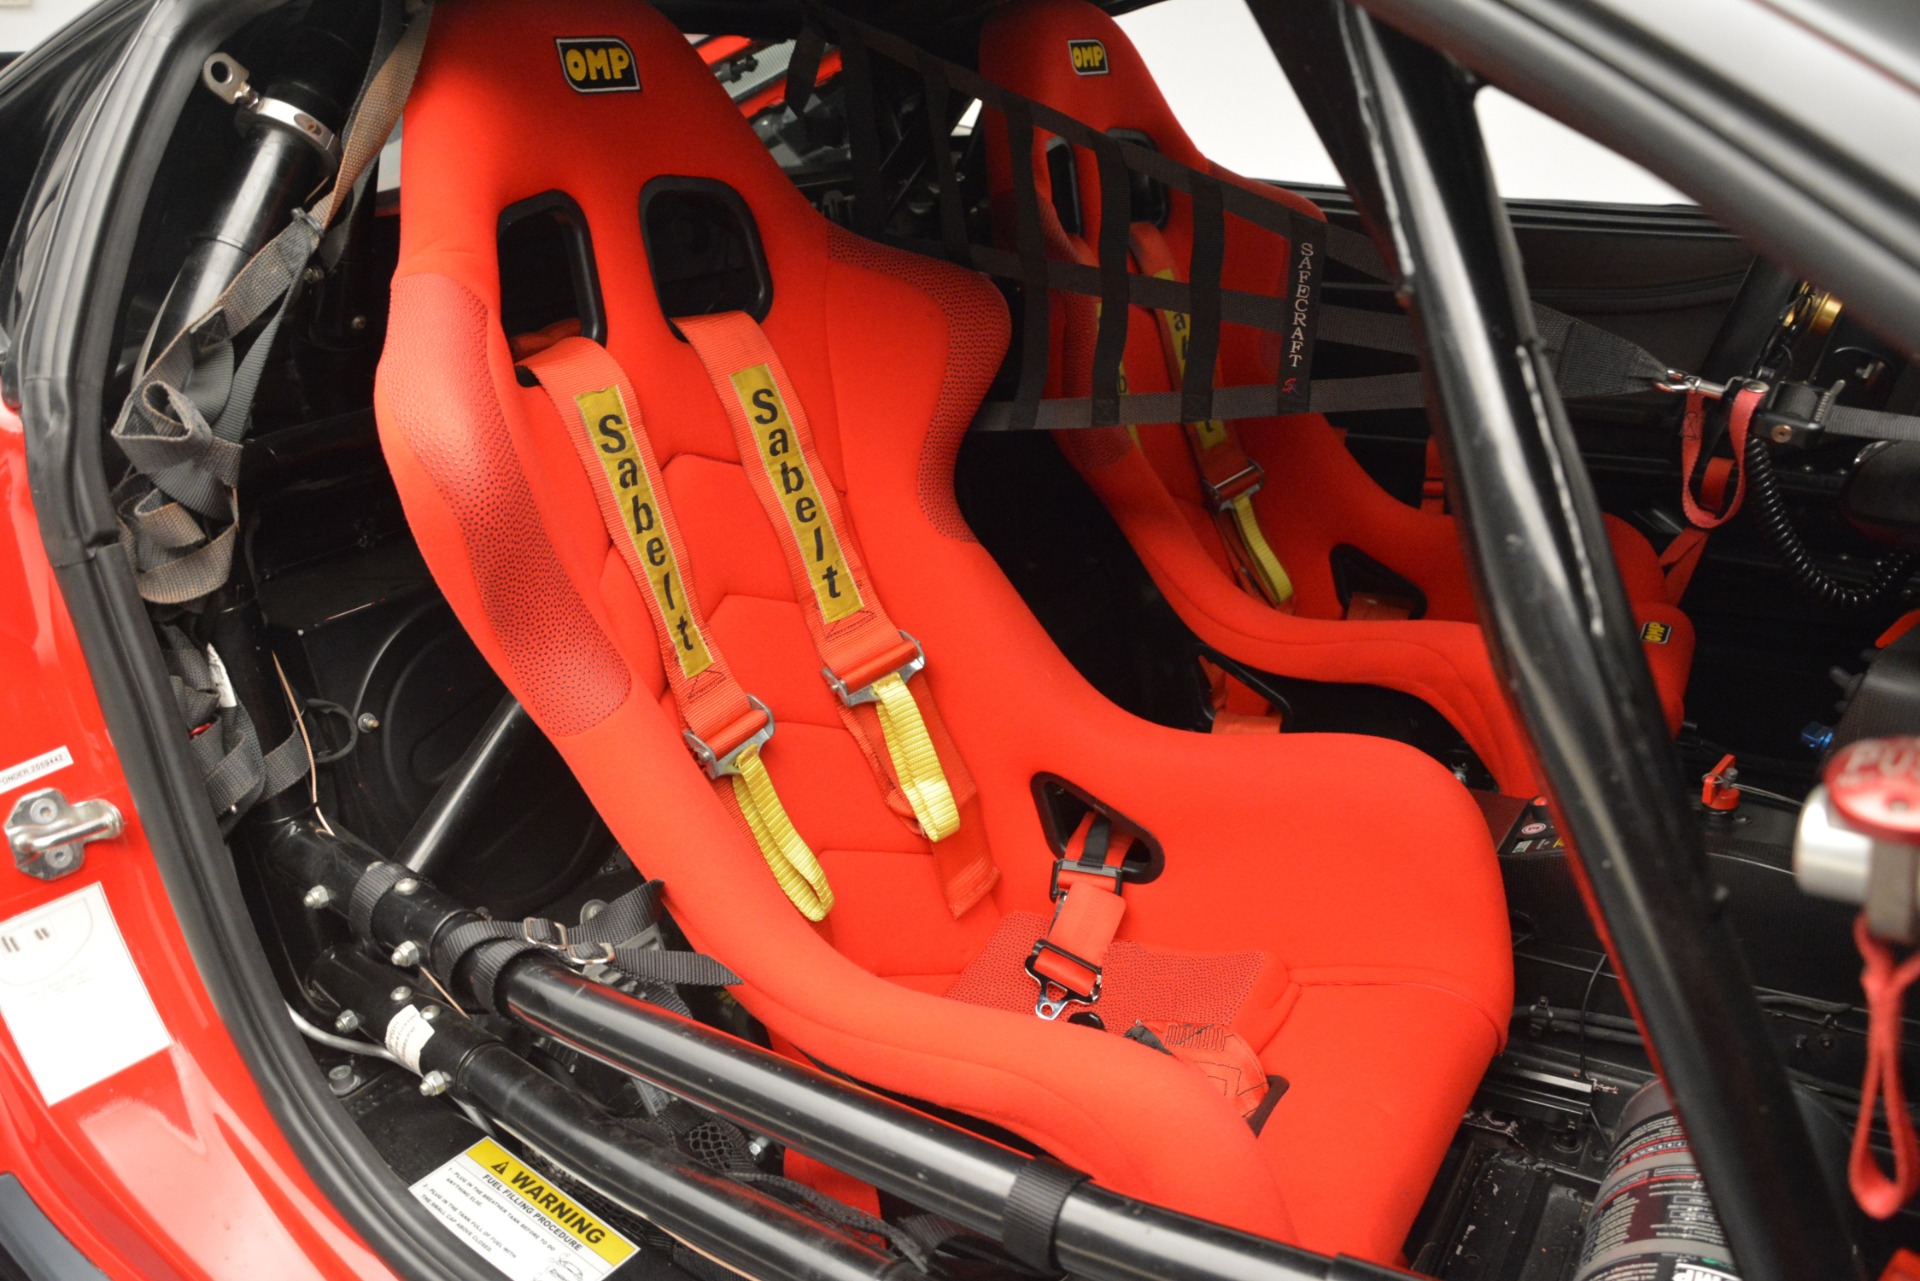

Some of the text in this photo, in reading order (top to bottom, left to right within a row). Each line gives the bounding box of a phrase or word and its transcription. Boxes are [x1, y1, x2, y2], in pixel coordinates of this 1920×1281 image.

[565, 48, 629, 81] OMP
[1072, 46, 1104, 68] OMP
[1289, 242, 1314, 368] SAFECRAFT
[752, 388, 841, 599] Sabelt
[598, 413, 693, 651] Sabelt
[1, 768, 30, 784] ONDER
[1842, 737, 1920, 778] PU
[420, 1193, 431, 1203] THE
[430, 1201, 446, 1215] SMALL
[445, 1213, 457, 1223] CAP
[455, 1222, 473, 1236] ABOVE
[445, 1177, 470, 1197] ANYTHING
[453, 1171, 467, 1183] PLUG
[472, 1185, 483, 1195] THE
[481, 1193, 507, 1213] BREATHER
[506, 1212, 520, 1224] TANK
[519, 1223, 540, 1239] BEFORE
[482, 1173, 582, 1251] FUEL FILLING PROCEDURE
[510, 1170, 606, 1246] WARNING
[428, 1188, 443, 1200] PLUG
[447, 1202, 458, 1212] THE
[457, 1210, 471, 1222] TANK
[470, 1220, 483, 1232] FULL
[489, 1236, 503, 1248] FUEL
[502, 1246, 517, 1258] WITH
